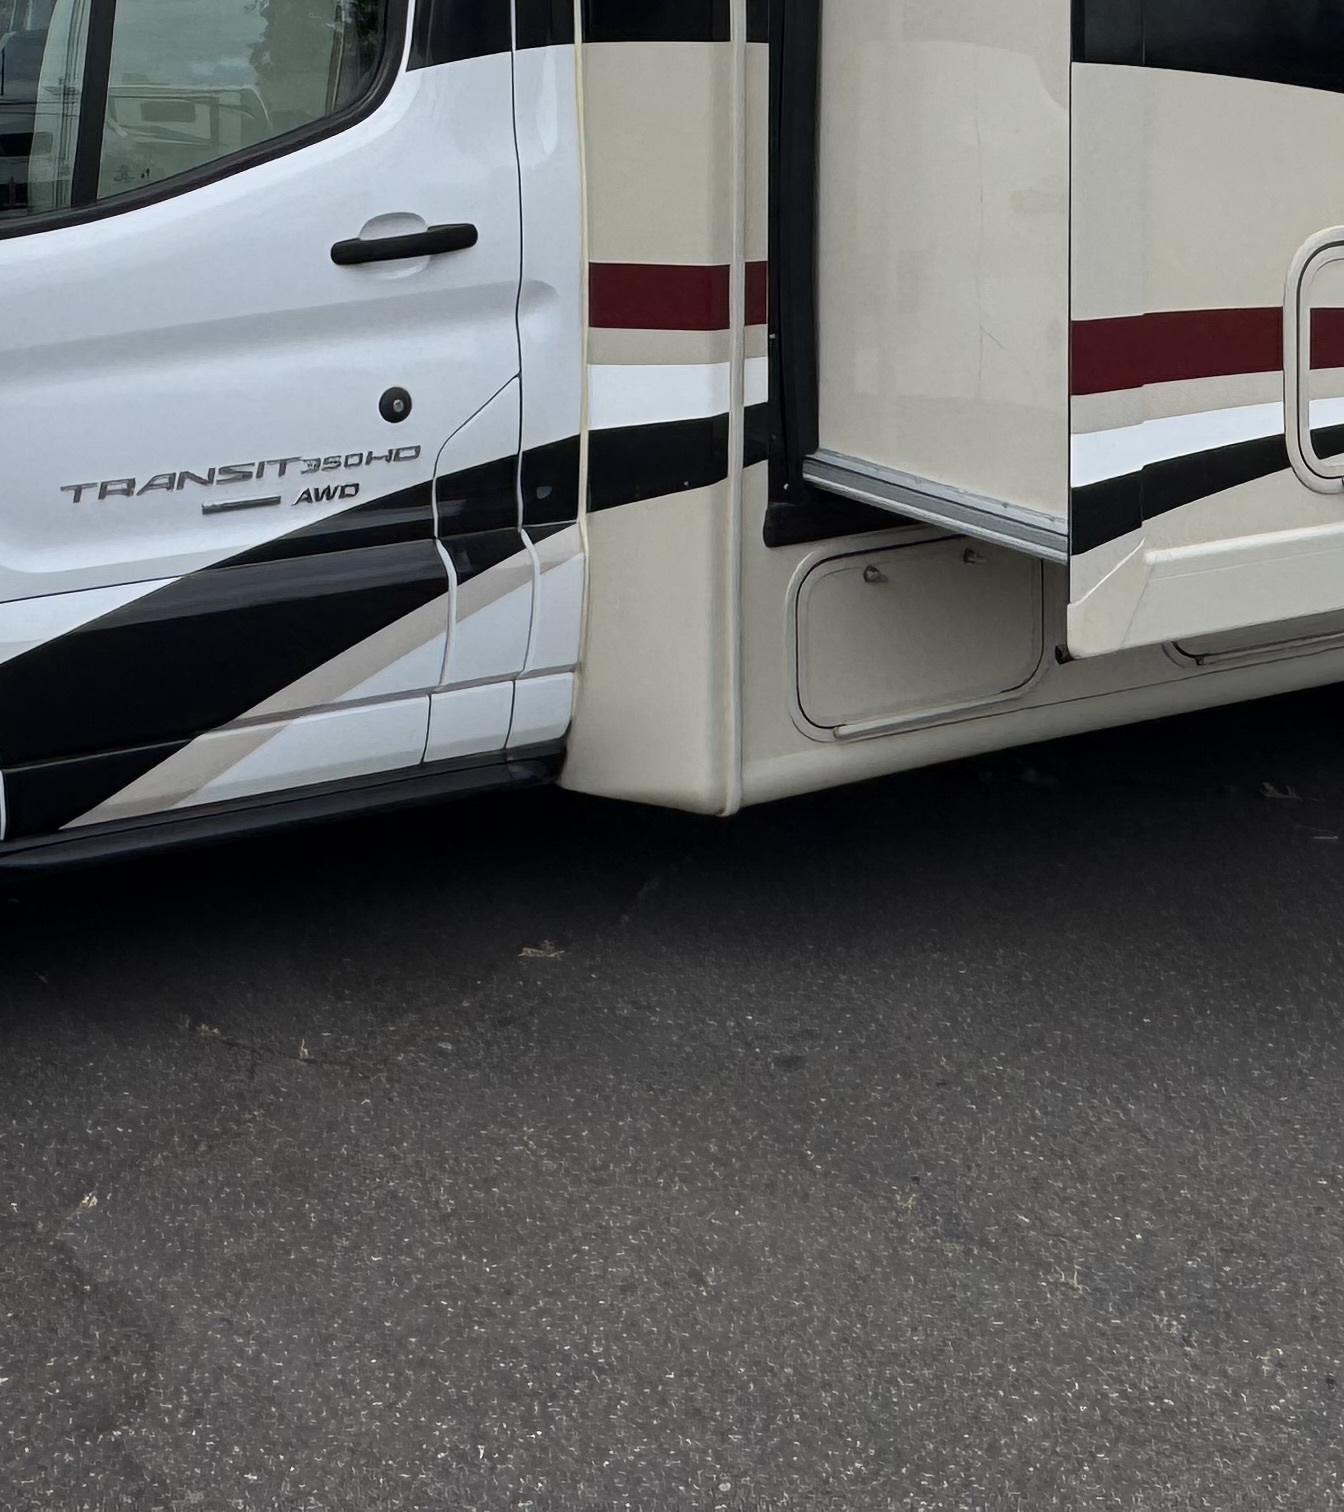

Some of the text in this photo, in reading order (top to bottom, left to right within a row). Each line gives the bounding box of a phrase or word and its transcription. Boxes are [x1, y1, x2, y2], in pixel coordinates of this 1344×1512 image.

[60, 445, 422, 504] TRANSIT 350HD
[293, 482, 360, 505] AWD
